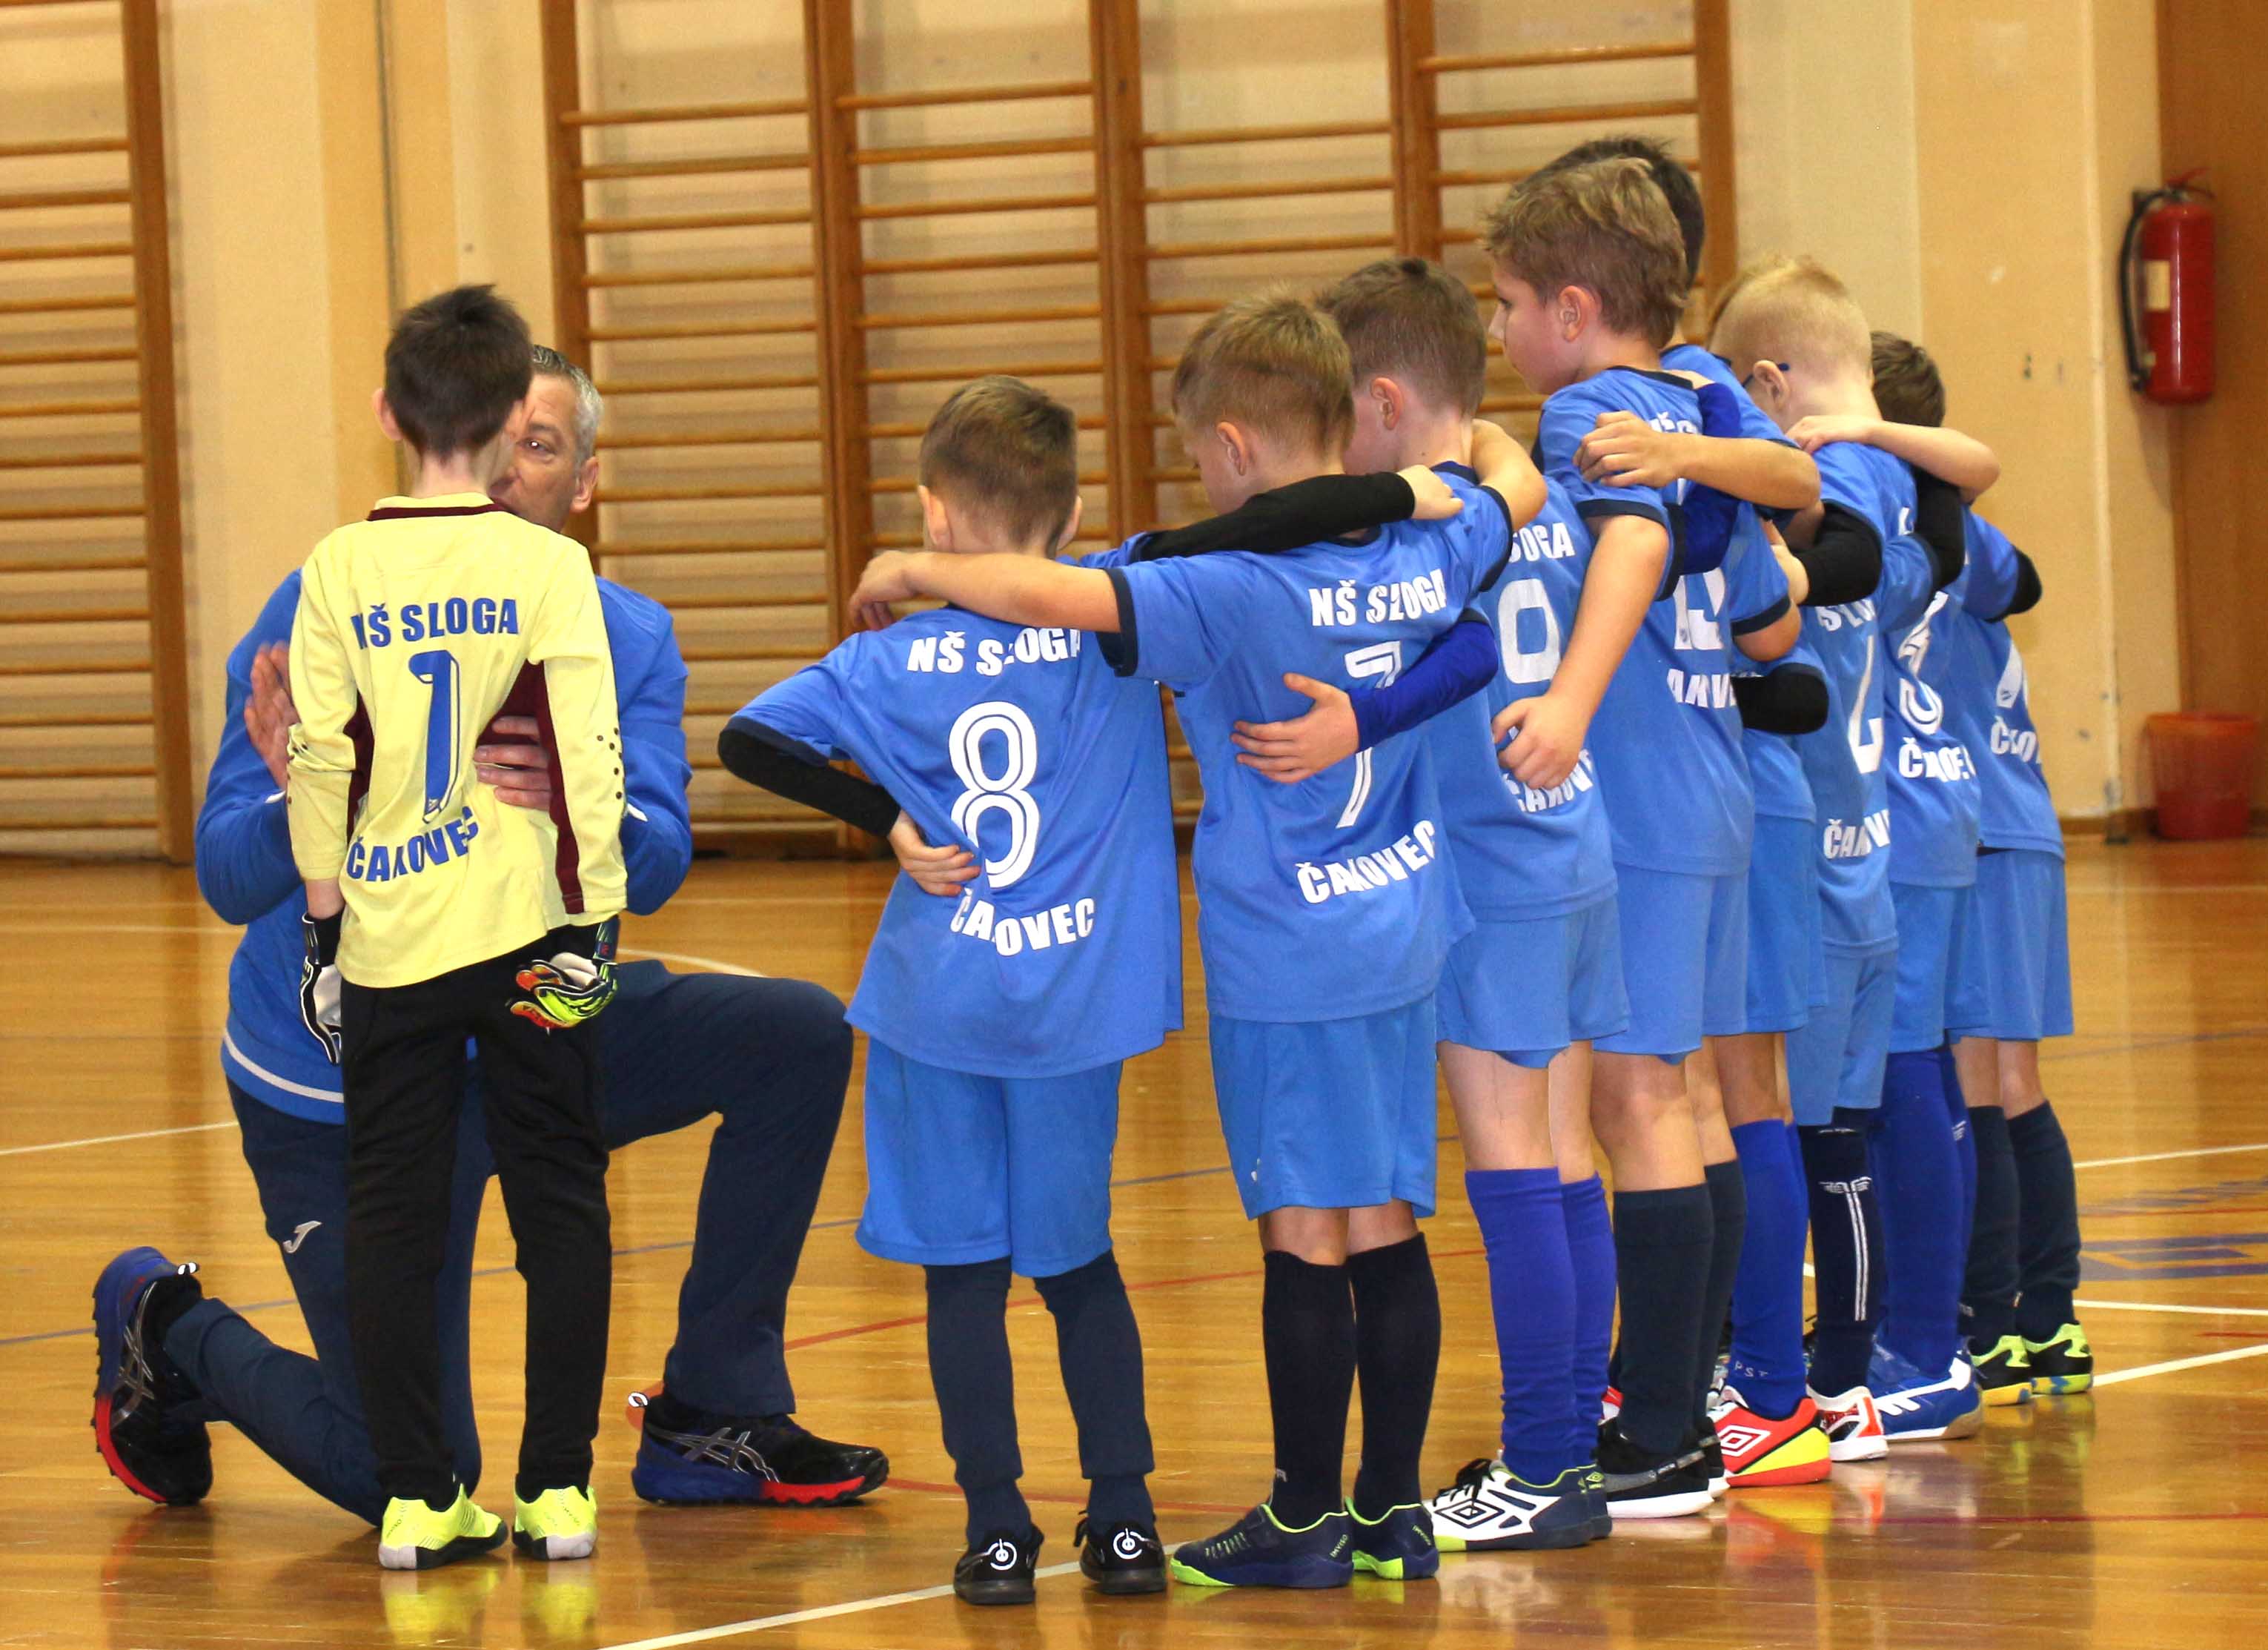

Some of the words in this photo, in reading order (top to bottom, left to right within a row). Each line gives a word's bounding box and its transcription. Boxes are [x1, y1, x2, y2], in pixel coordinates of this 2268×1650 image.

[401, 597, 520, 641] SLOGA
[1308, 580, 1356, 626] NŠ
[907, 631, 966, 673] NŠ
[408, 649, 460, 824] 1
[1336, 640, 1402, 829] 7
[949, 700, 1041, 889] 8
[950, 887, 1095, 956] ČAOVEC
